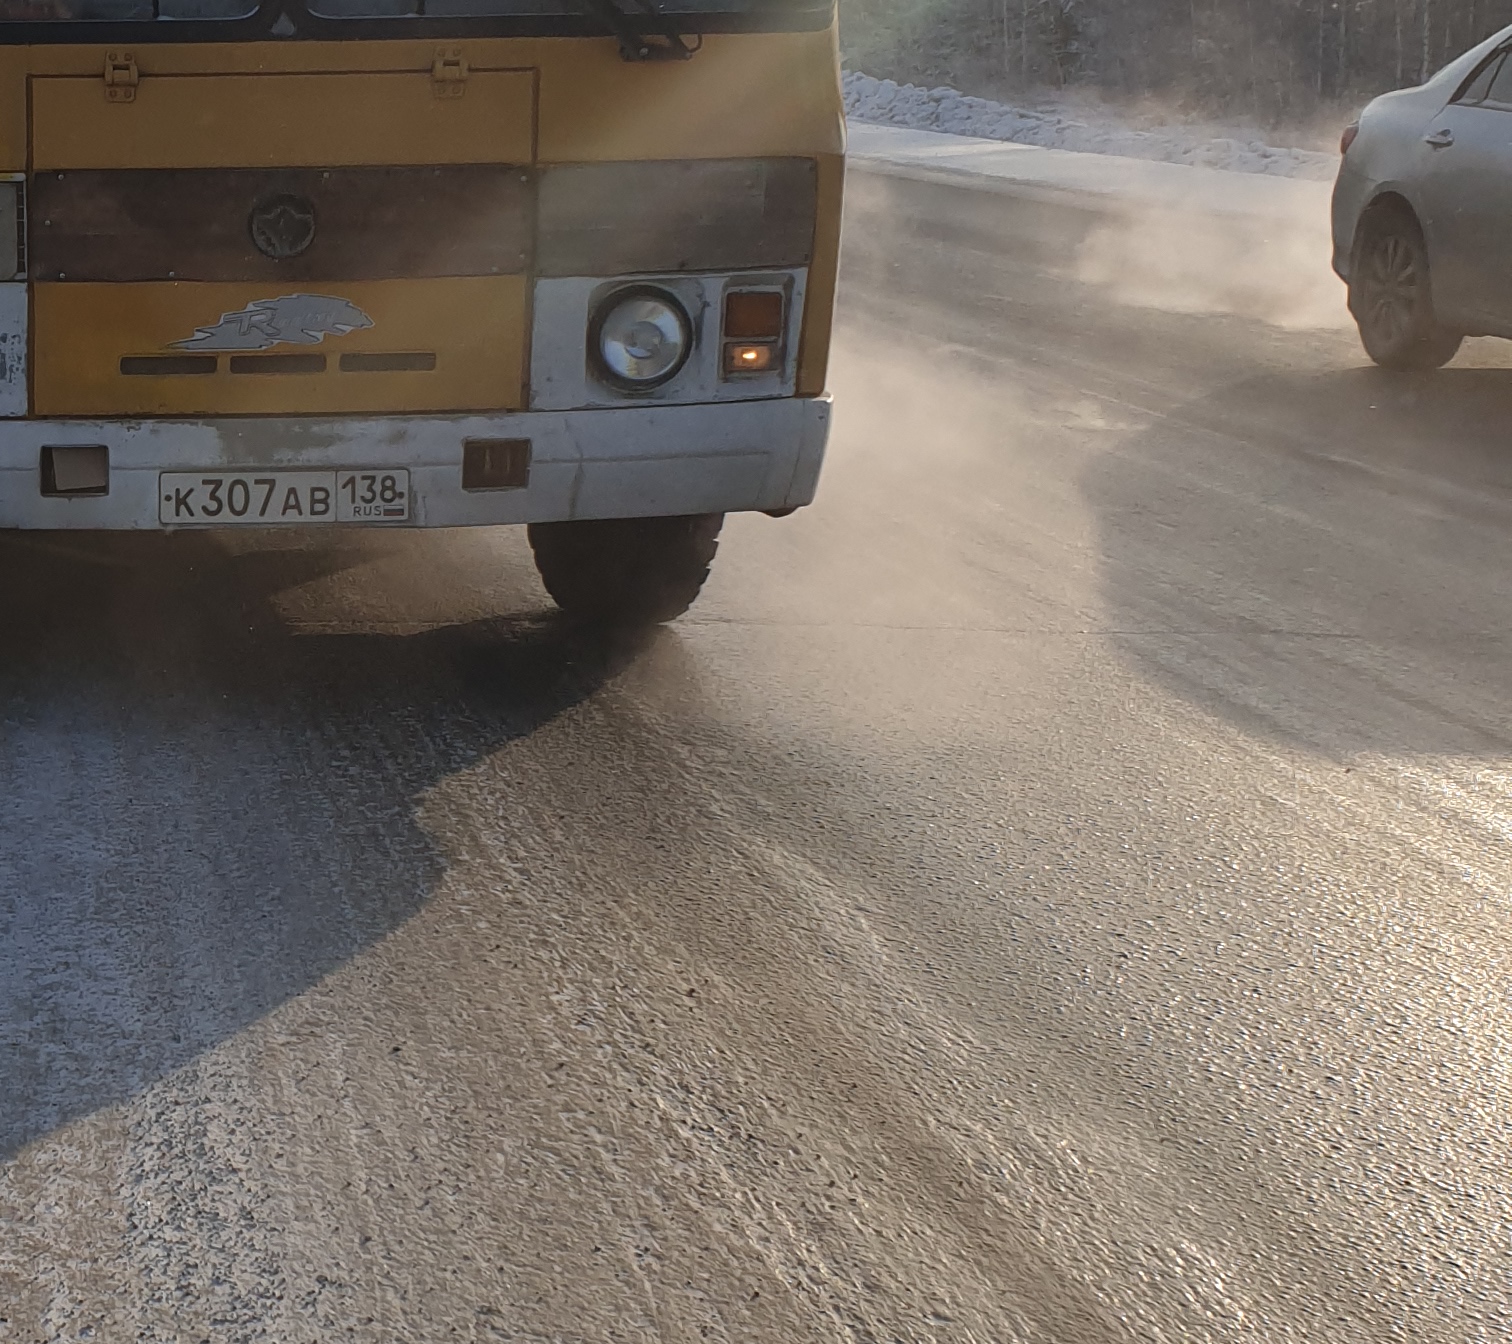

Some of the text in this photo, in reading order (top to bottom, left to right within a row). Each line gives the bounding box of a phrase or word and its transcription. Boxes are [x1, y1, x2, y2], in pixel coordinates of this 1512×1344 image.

[174, 474, 397, 517] К307АВ 138
[353, 506, 382, 517] RUS
